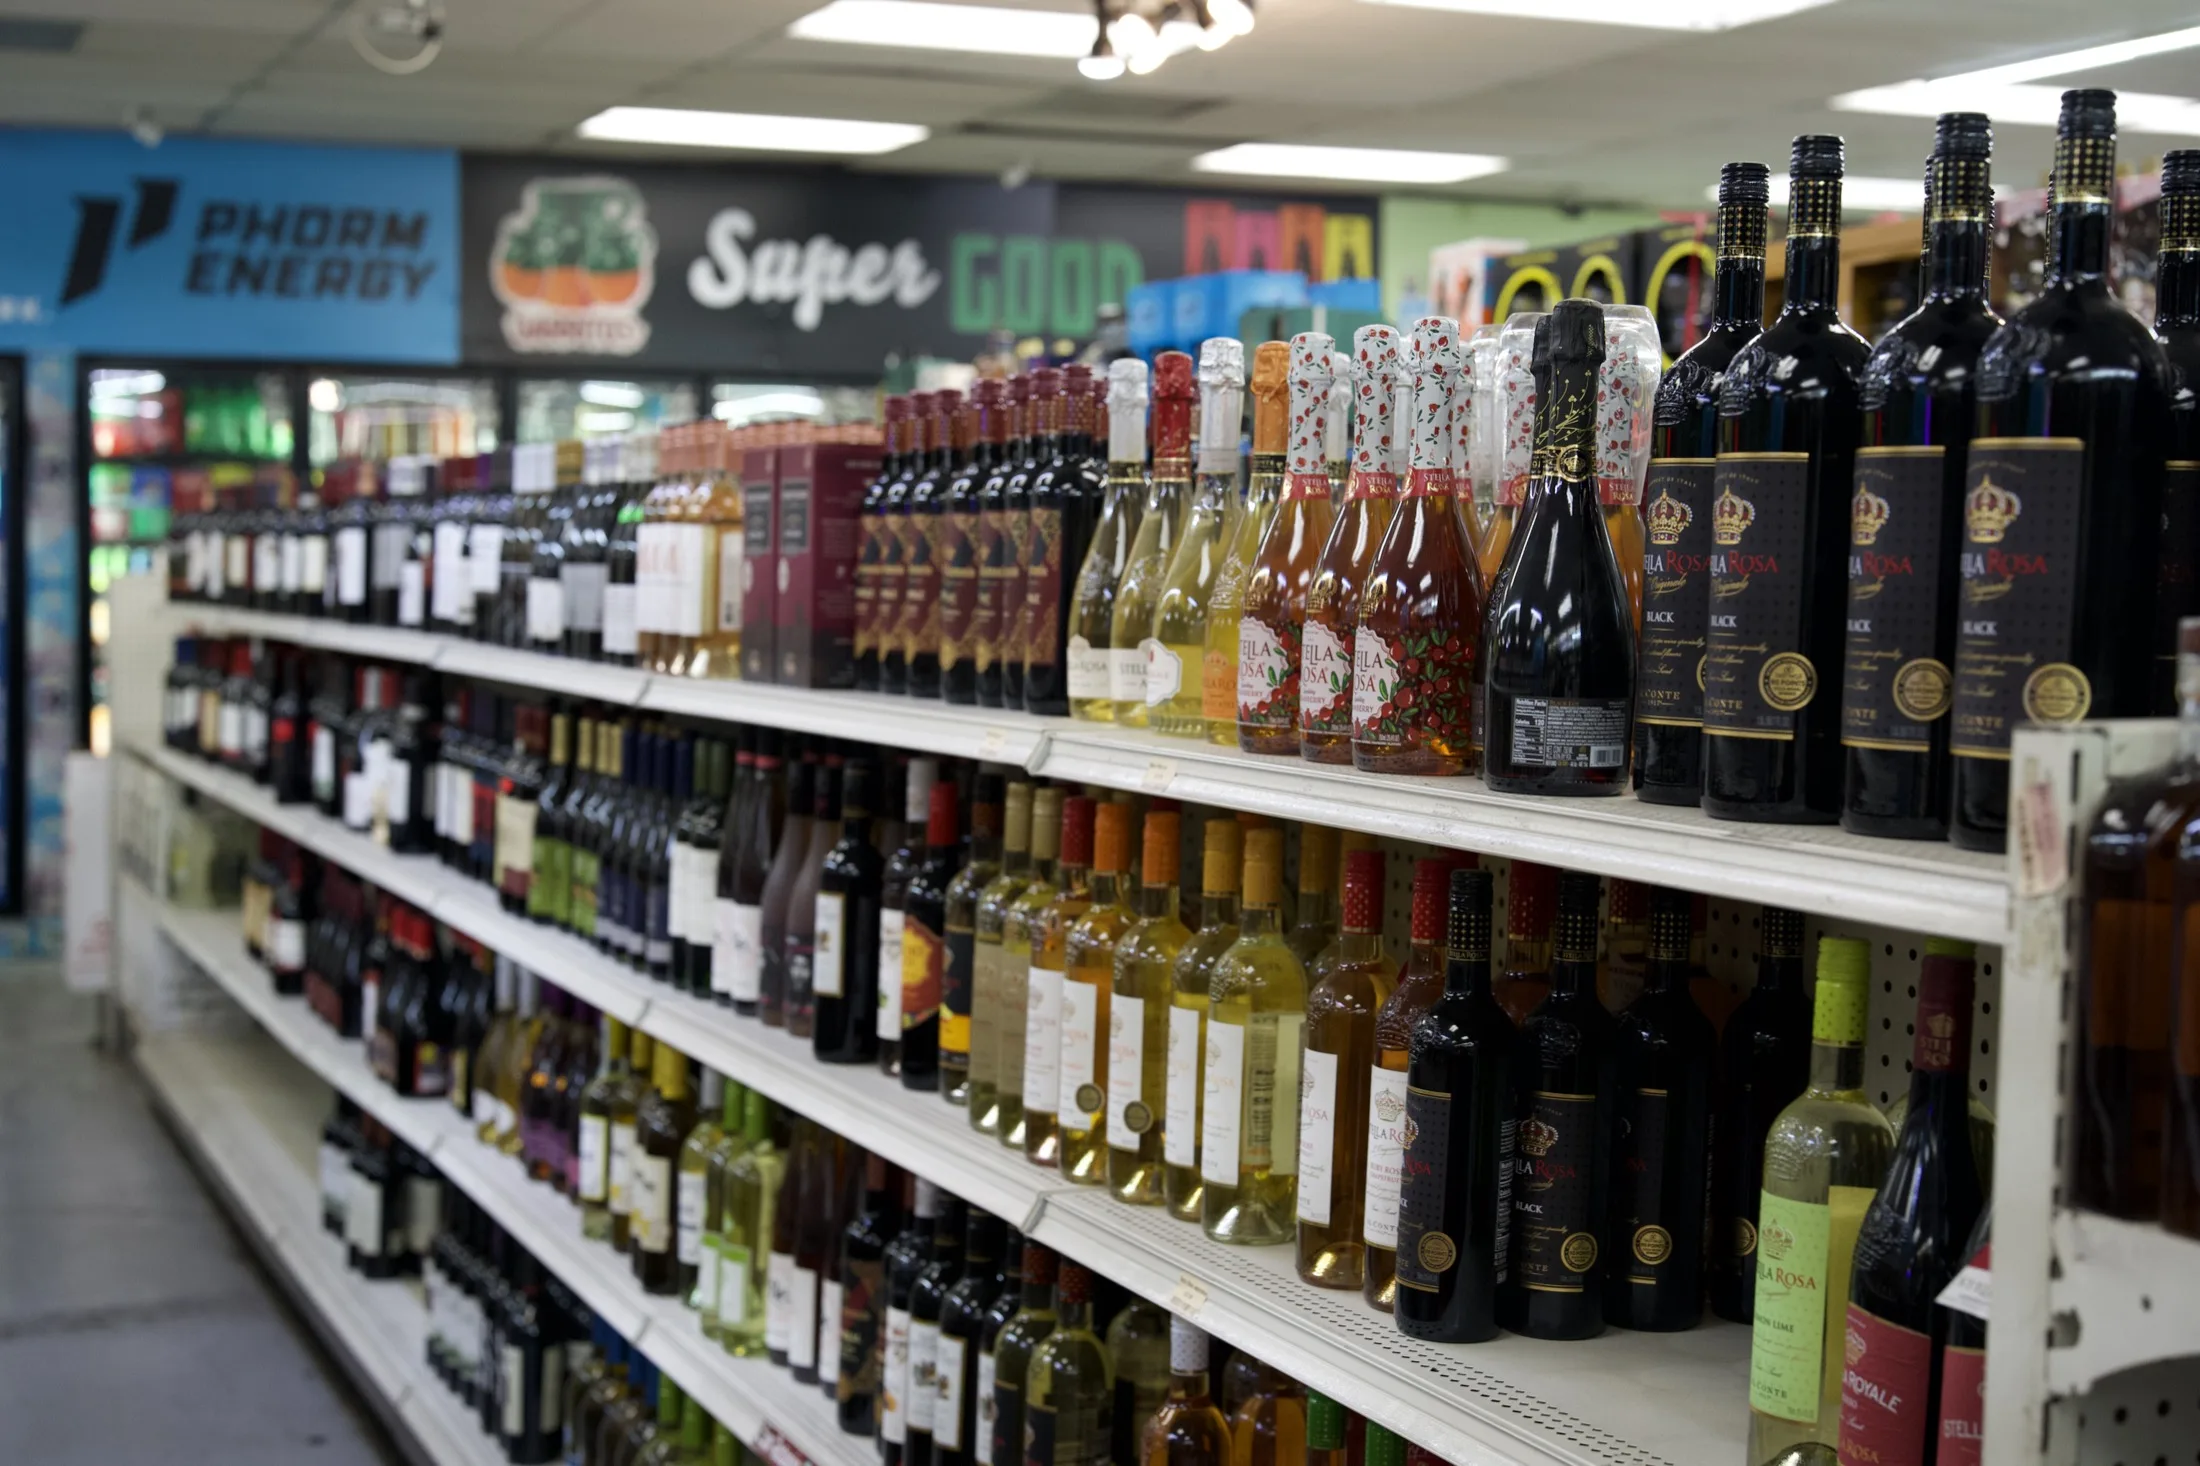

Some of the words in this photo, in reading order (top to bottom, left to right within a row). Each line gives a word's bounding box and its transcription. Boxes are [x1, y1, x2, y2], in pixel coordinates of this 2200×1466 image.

[197, 201, 429, 250] PHORM
[186, 252, 435, 302] ENERGY
[688, 207, 940, 331] Super
[1302, 477, 1328, 488] STELLA
[1365, 476, 1393, 487] STELLA
[1422, 472, 1450, 484] STELLA
[1728, 551, 1778, 575] ROSA
[1863, 550, 1913, 578] ROSA
[1987, 548, 2049, 578] ROSA
[1646, 611, 1675, 623] BLACK
[1535, 1159, 1576, 1180] ROSA
[1515, 1200, 1544, 1214] BLACK
[1775, 1267, 1817, 1291] ROSA
[1772, 1319, 1795, 1334] LIME
[1849, 1371, 1902, 1414] ROYALE
